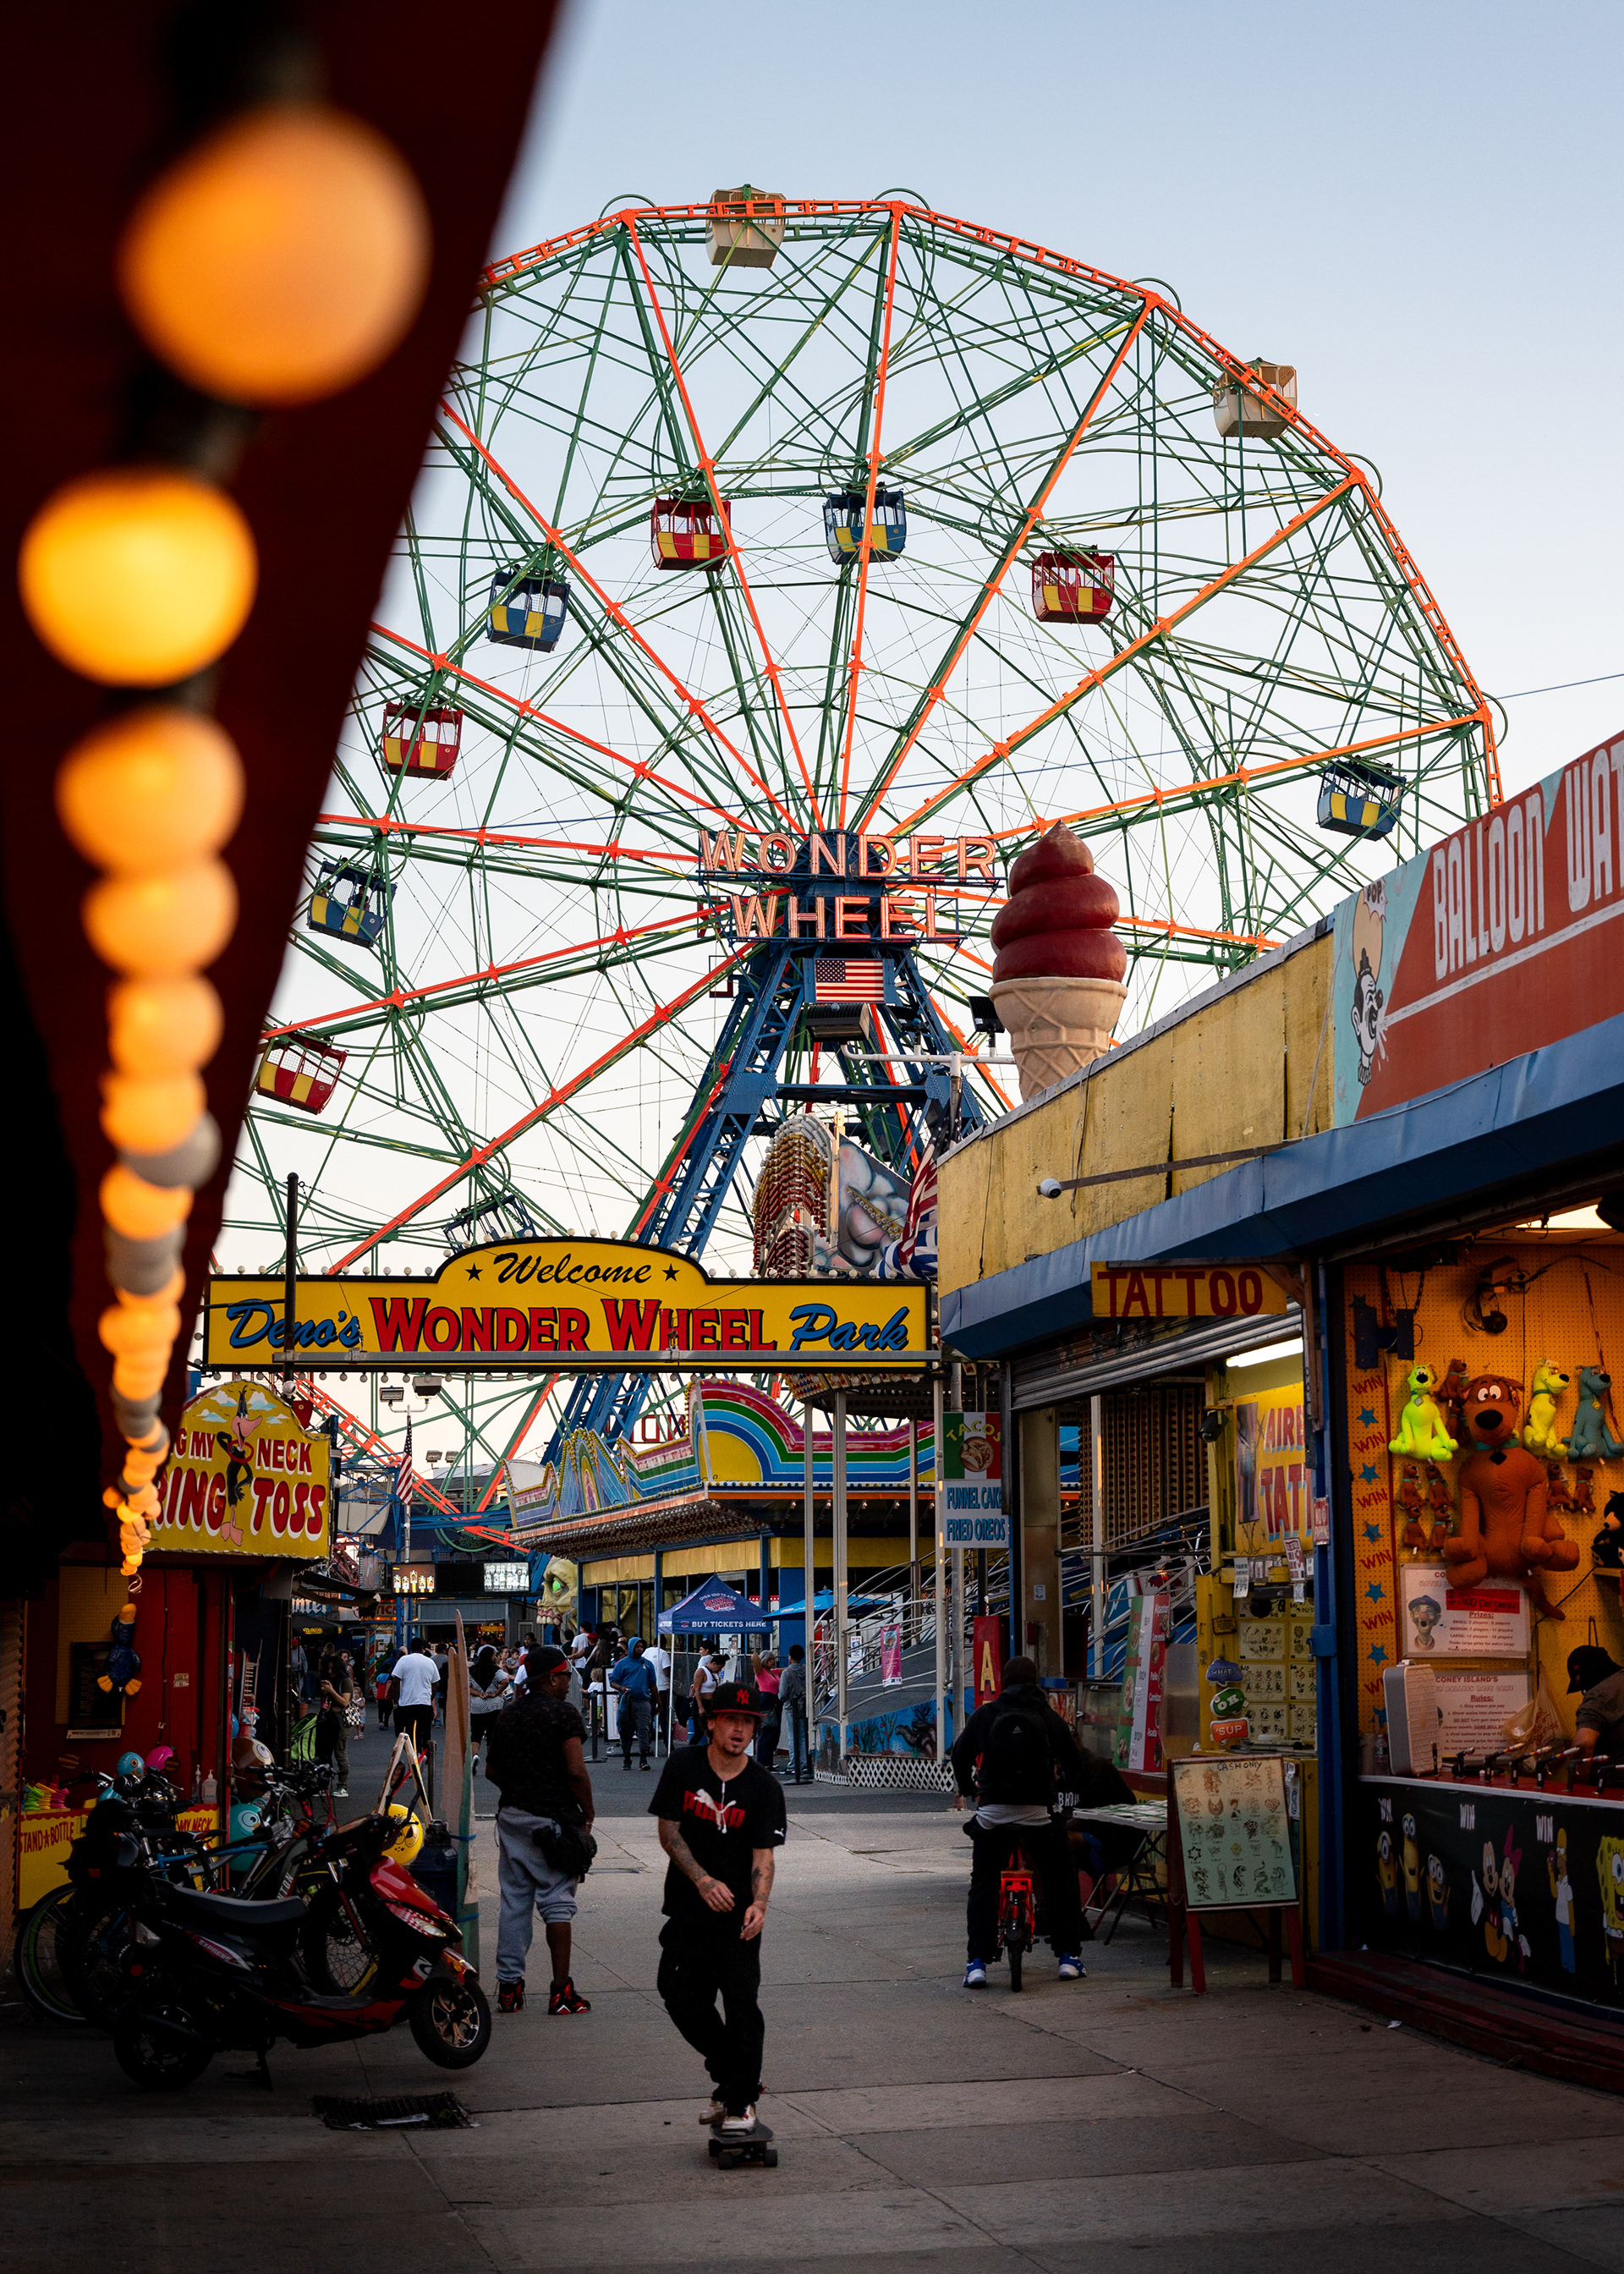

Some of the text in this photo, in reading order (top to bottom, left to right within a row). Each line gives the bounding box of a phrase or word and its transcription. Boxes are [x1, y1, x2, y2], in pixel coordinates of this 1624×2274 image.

[699, 830, 996, 882] WONDER
[1432, 792, 1545, 981] BALLOON
[731, 894, 960, 942] WHEEL
[493, 1252, 653, 1284] Welcome
[1096, 1271, 1264, 1317] TATTOO
[227, 1297, 911, 1352] Deno's WONDER WHEEL Park
[1352, 1376, 1384, 1394] WIN
[188, 1431, 217, 1462] MY
[255, 1437, 313, 1475] NECK
[1353, 1431, 1385, 1453] WIN
[250, 1477, 326, 1541] TOSS
[946, 1486, 980, 1509] FUNNEL
[1357, 1489, 1388, 1508] WIN
[946, 1518, 1006, 1541] FRIED OREOS
[1360, 1549, 1392, 1569] WIN
[721, 1592, 738, 1601] YEARS
[1363, 1610, 1395, 1630] WIN
[1363, 1678, 1384, 1695] WI
[1216, 1762, 1242, 1771] CASH
[1377, 1797, 1393, 1823] WIN
[1459, 1802, 1475, 1831] WIN
[179, 1817, 213, 1832] MY NECK
[1536, 1814, 1554, 1843] WIN
[198, 1939, 231, 1963] EXPRESS
